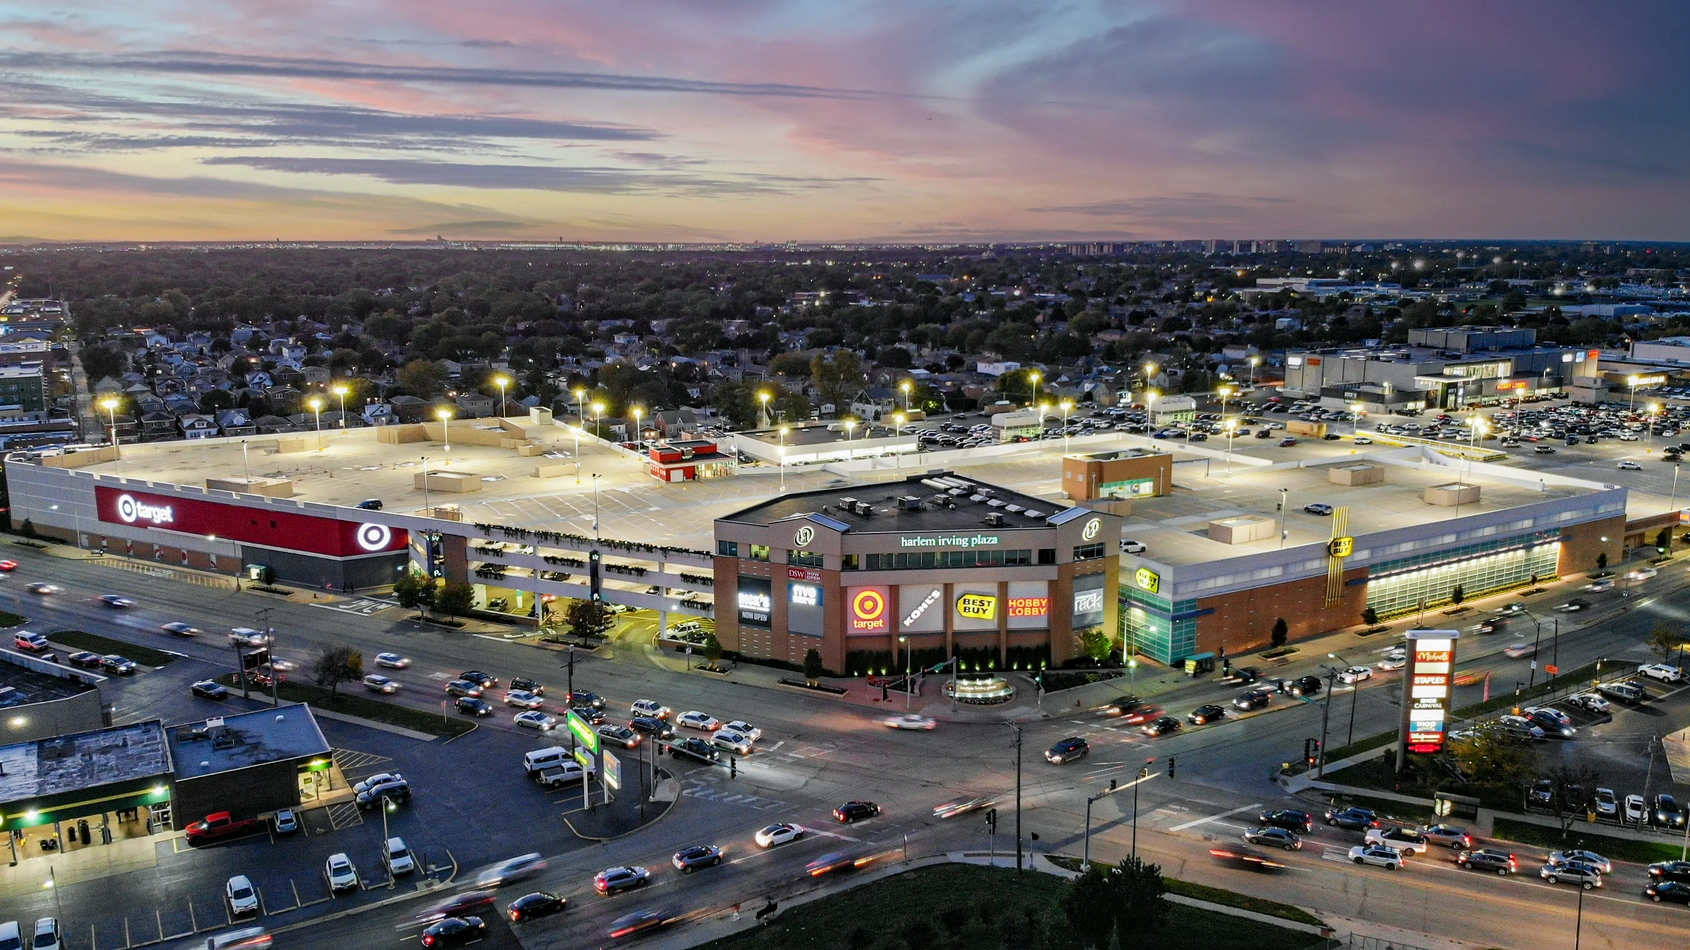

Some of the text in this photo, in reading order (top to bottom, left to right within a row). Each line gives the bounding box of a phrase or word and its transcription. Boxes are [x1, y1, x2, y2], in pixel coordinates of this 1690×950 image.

[136, 501, 173, 524] target
[901, 534, 998, 548] harlem irving plaza
[788, 569, 805, 578] DSW
[962, 598, 993, 607] BEST
[1008, 598, 1048, 607] HOBBY
[1074, 593, 1102, 611] rack
[903, 589, 941, 627] KOHL'S
[963, 606, 988, 614] BUY
[1009, 607, 1047, 616] LOBBY
[742, 611, 767, 621] NOW OPEN
[853, 619, 884, 630] target
[1414, 676, 1445, 684] STAPLES
